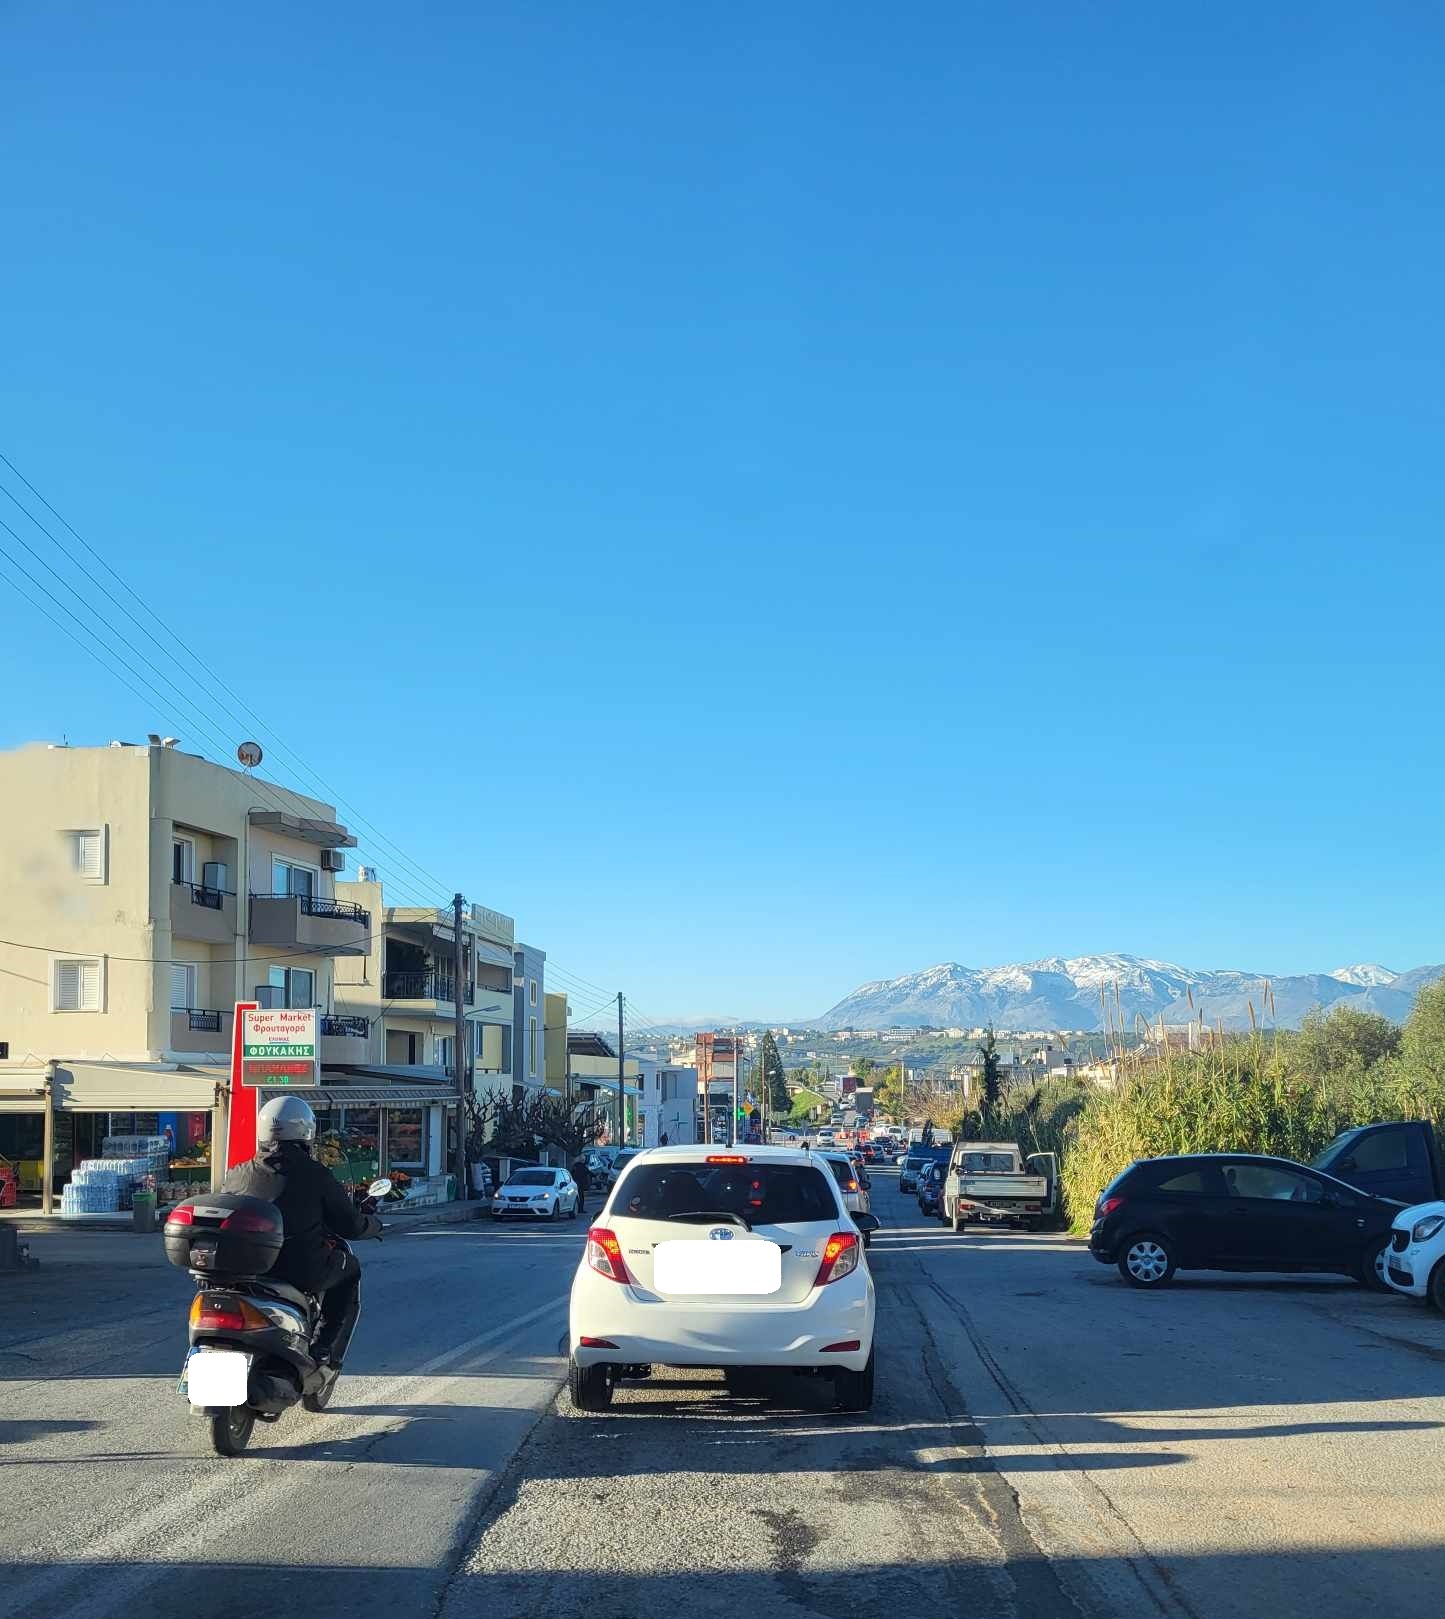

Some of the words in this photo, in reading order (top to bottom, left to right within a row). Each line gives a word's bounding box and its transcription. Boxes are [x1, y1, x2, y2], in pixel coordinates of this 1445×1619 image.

[248, 1013, 274, 1023] Super
[280, 1013, 311, 1022] Market
[250, 1046, 310, 1055] ΦΟΥΚΑΚΗΣ
